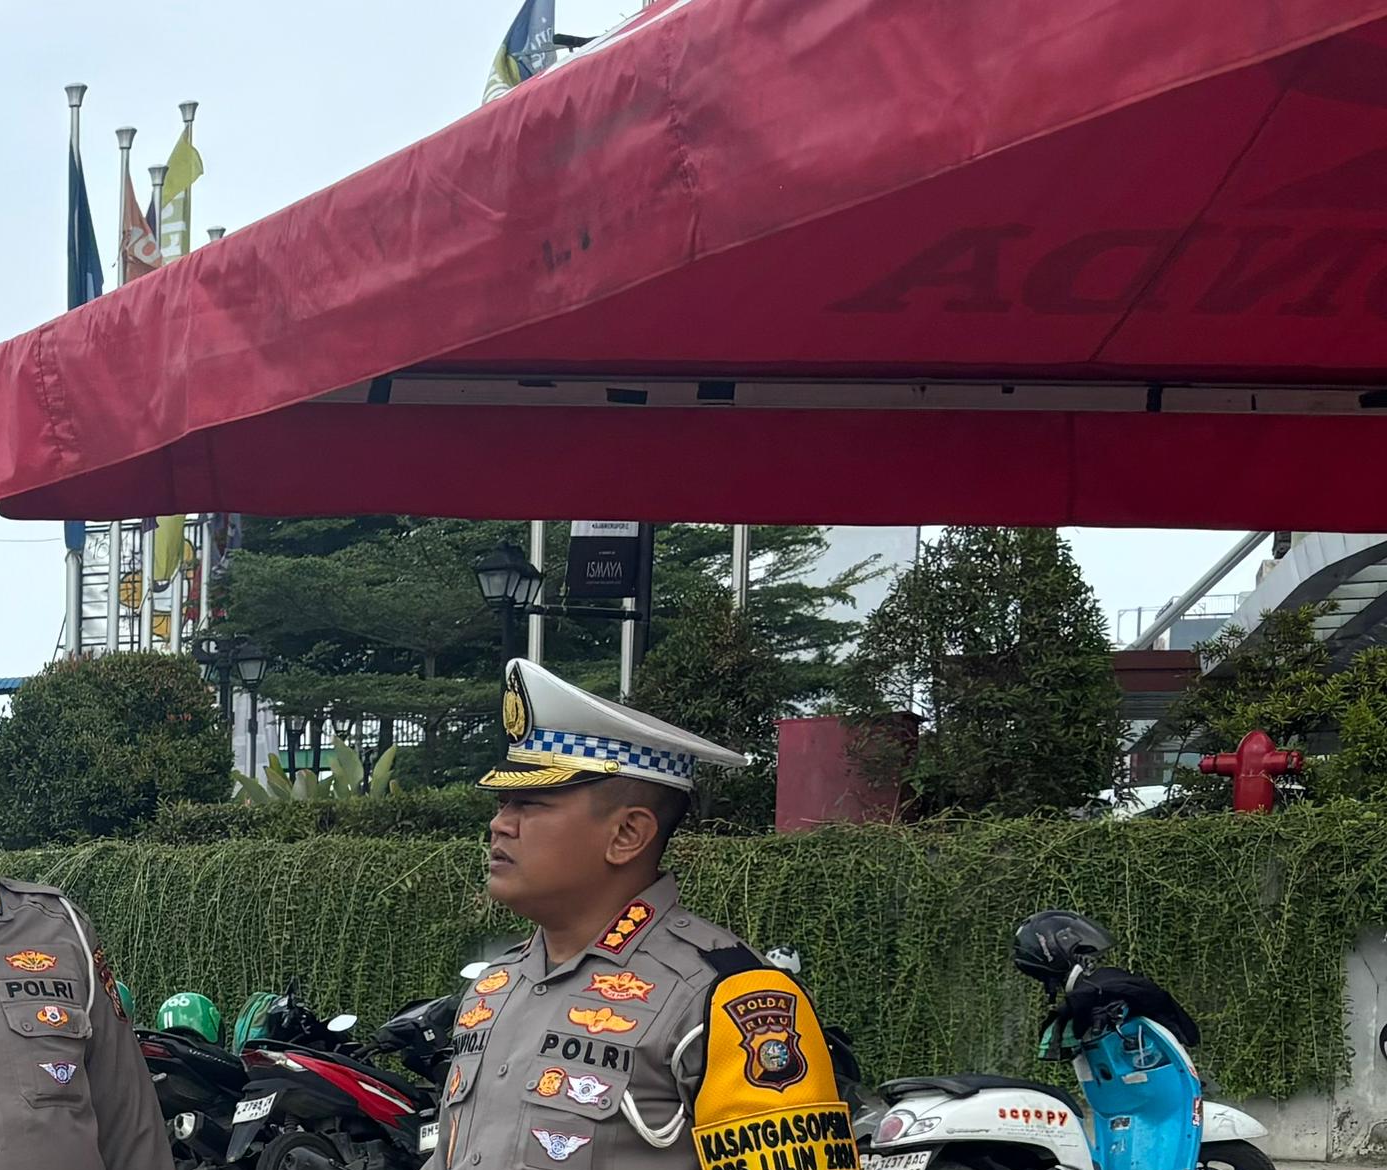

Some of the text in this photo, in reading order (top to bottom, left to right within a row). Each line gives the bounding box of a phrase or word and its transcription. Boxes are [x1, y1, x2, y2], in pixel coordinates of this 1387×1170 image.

[5, 980, 75, 1001] POLRI
[736, 997, 789, 1016] POLDA
[745, 1016, 790, 1032] RIAU
[539, 1033, 631, 1073] POLRI
[998, 1108, 1068, 1127] scoopy
